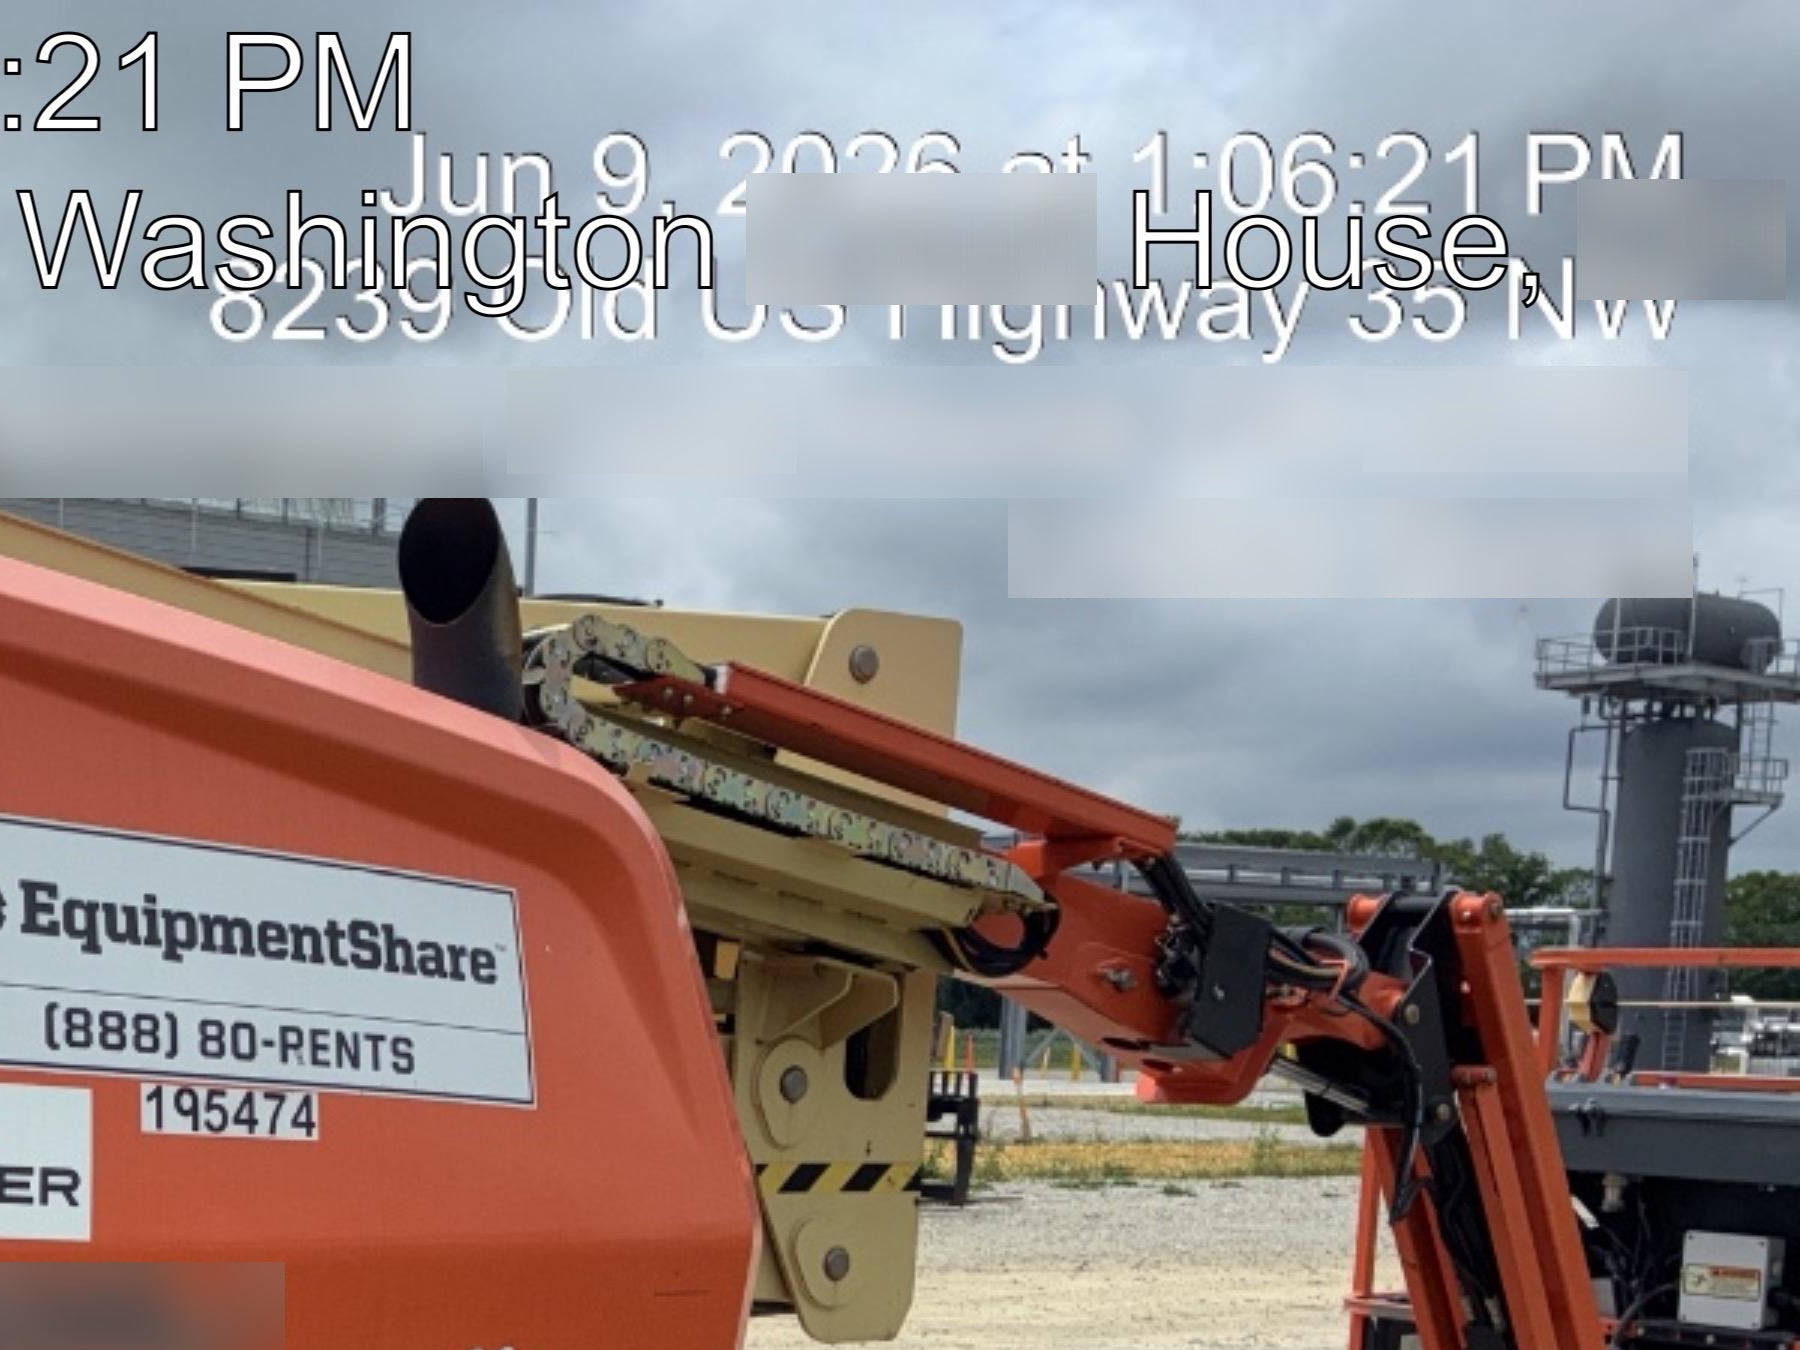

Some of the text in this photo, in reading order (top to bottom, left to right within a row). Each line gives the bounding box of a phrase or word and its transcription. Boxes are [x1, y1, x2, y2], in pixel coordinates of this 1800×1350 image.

[18, 878, 498, 985] EquipmentShare
[43, 1000, 417, 1075] (888) 80-RENTS
[144, 1085, 317, 1138] 195474
